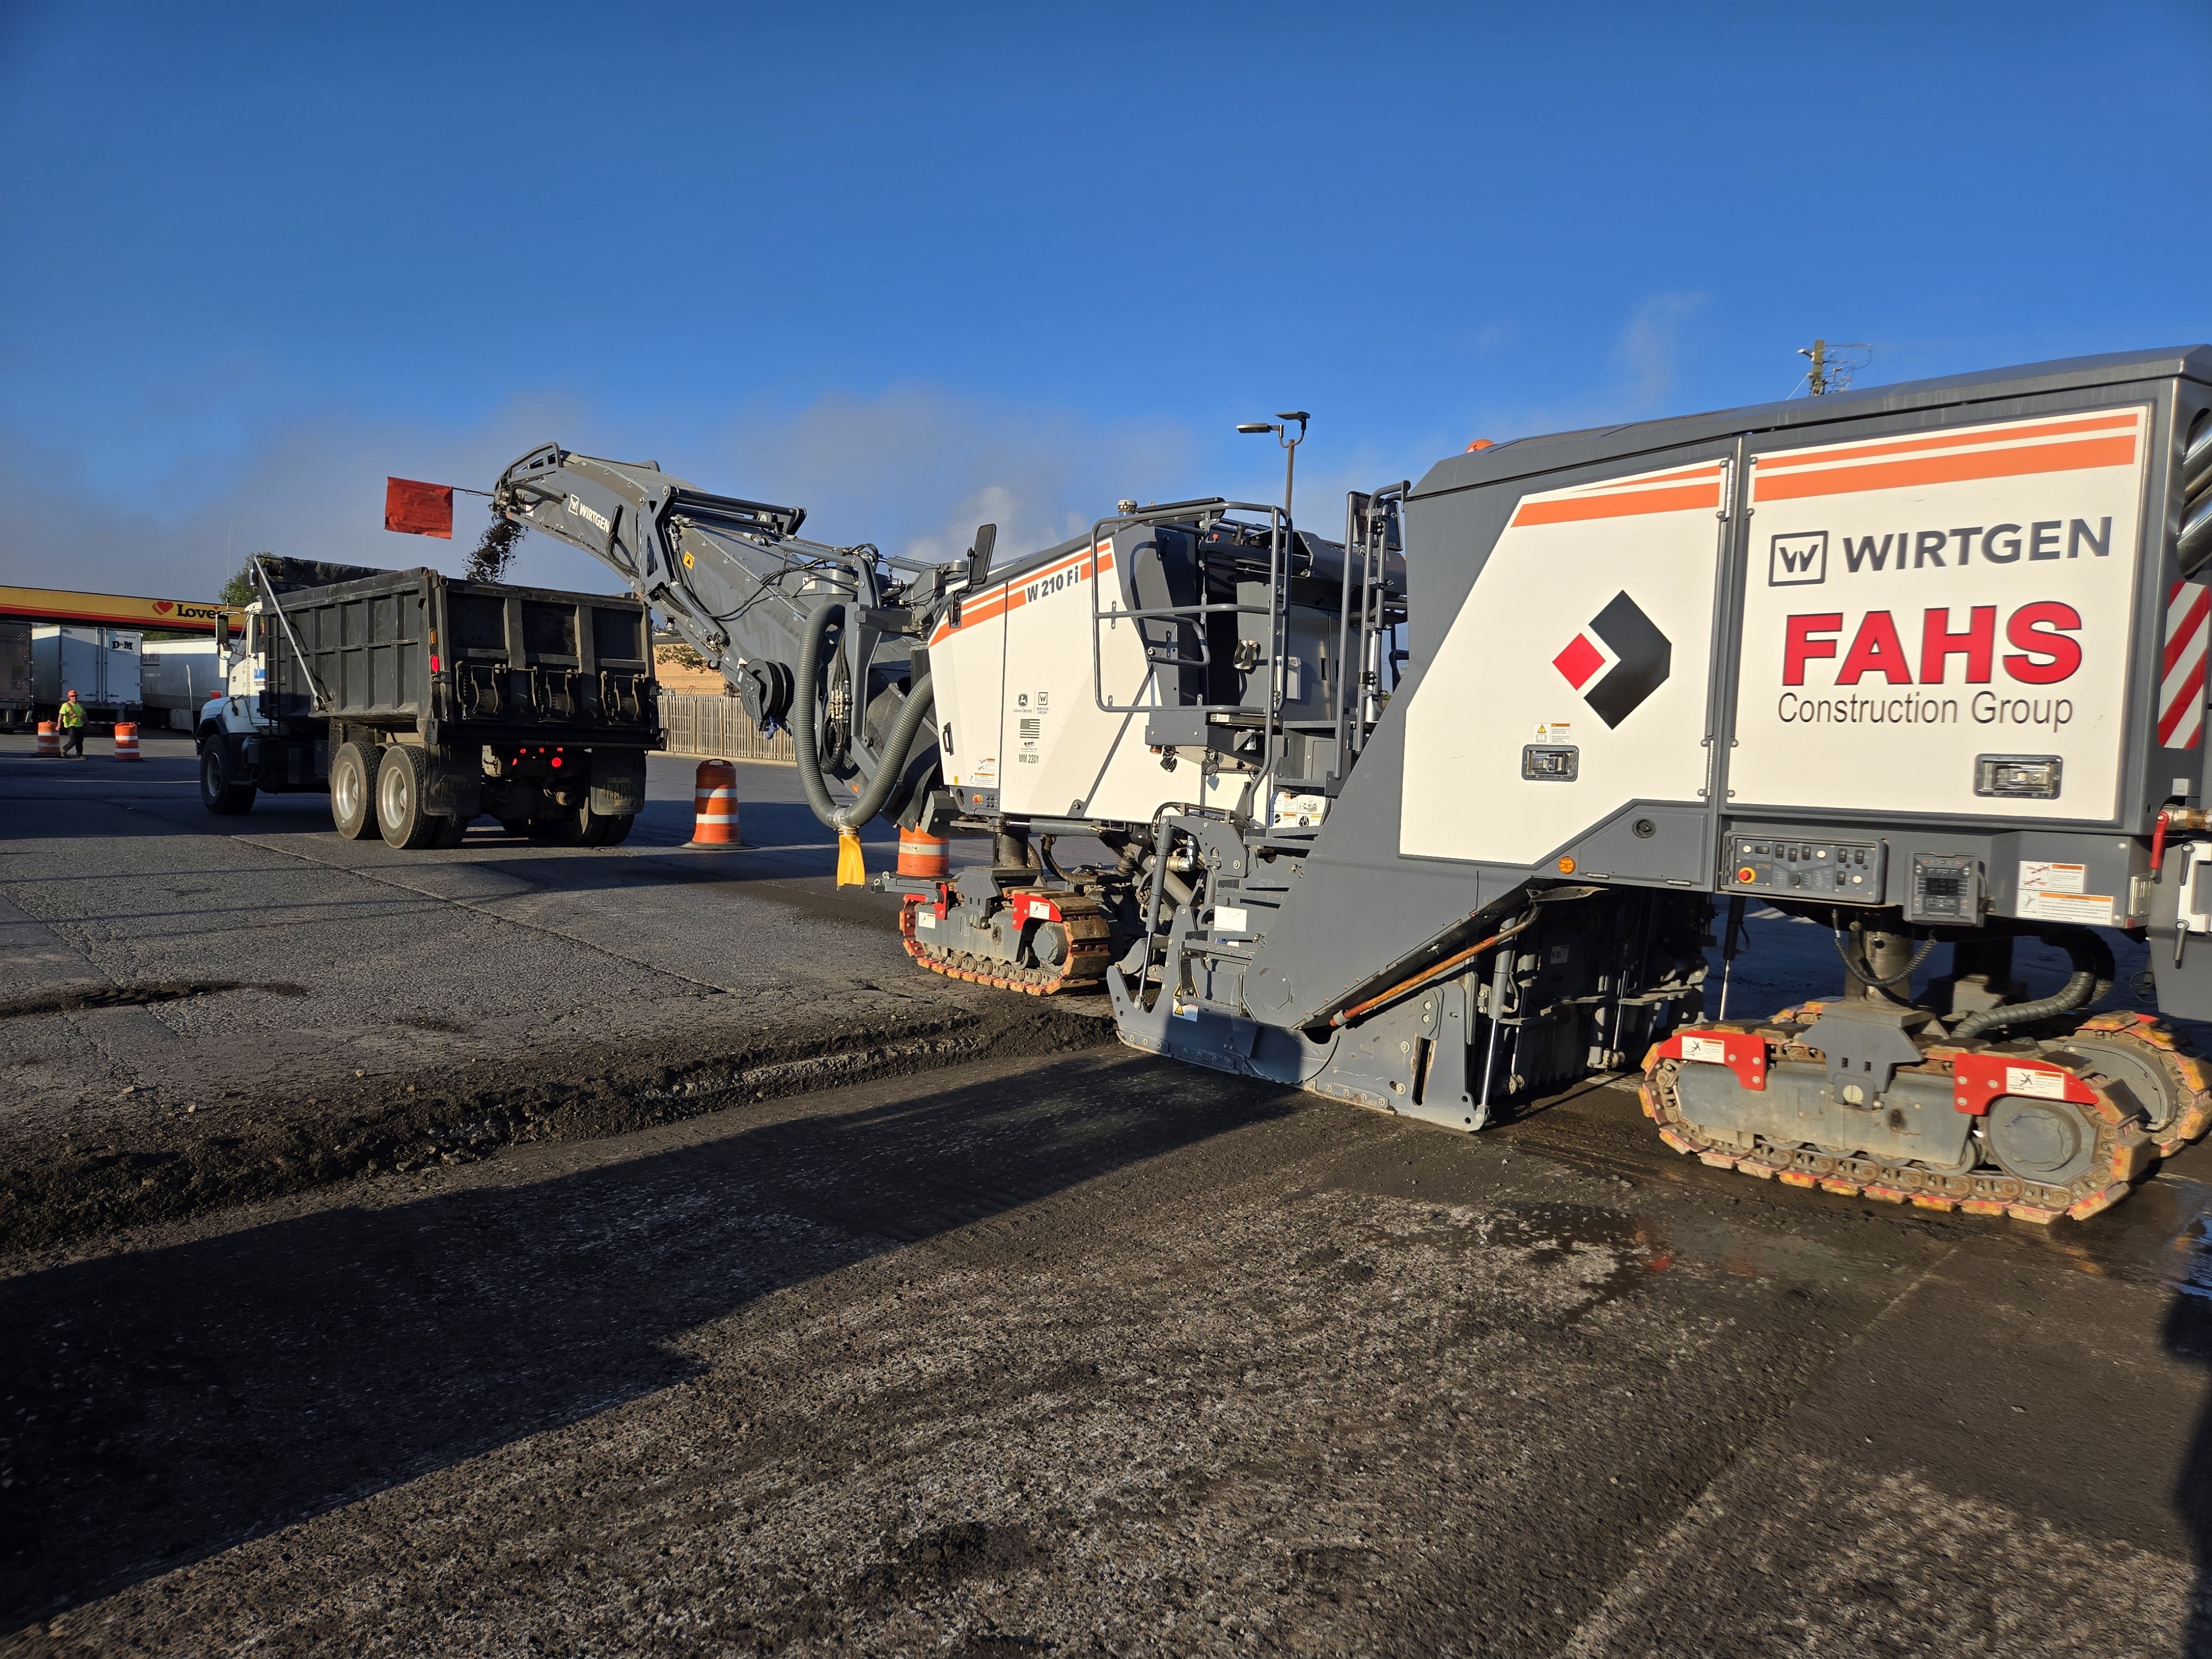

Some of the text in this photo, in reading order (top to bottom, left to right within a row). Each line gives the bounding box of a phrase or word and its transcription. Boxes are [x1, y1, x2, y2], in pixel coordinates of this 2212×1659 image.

[580, 503, 610, 533] WIRTGEN
[1842, 517, 2112, 573] WIRTGEN
[1027, 565, 1078, 603] W 210 Fi
[1782, 601, 2082, 686] FAHS
[1778, 691, 2074, 733] Construction Group
[1019, 754, 1039, 764] MM 2301
